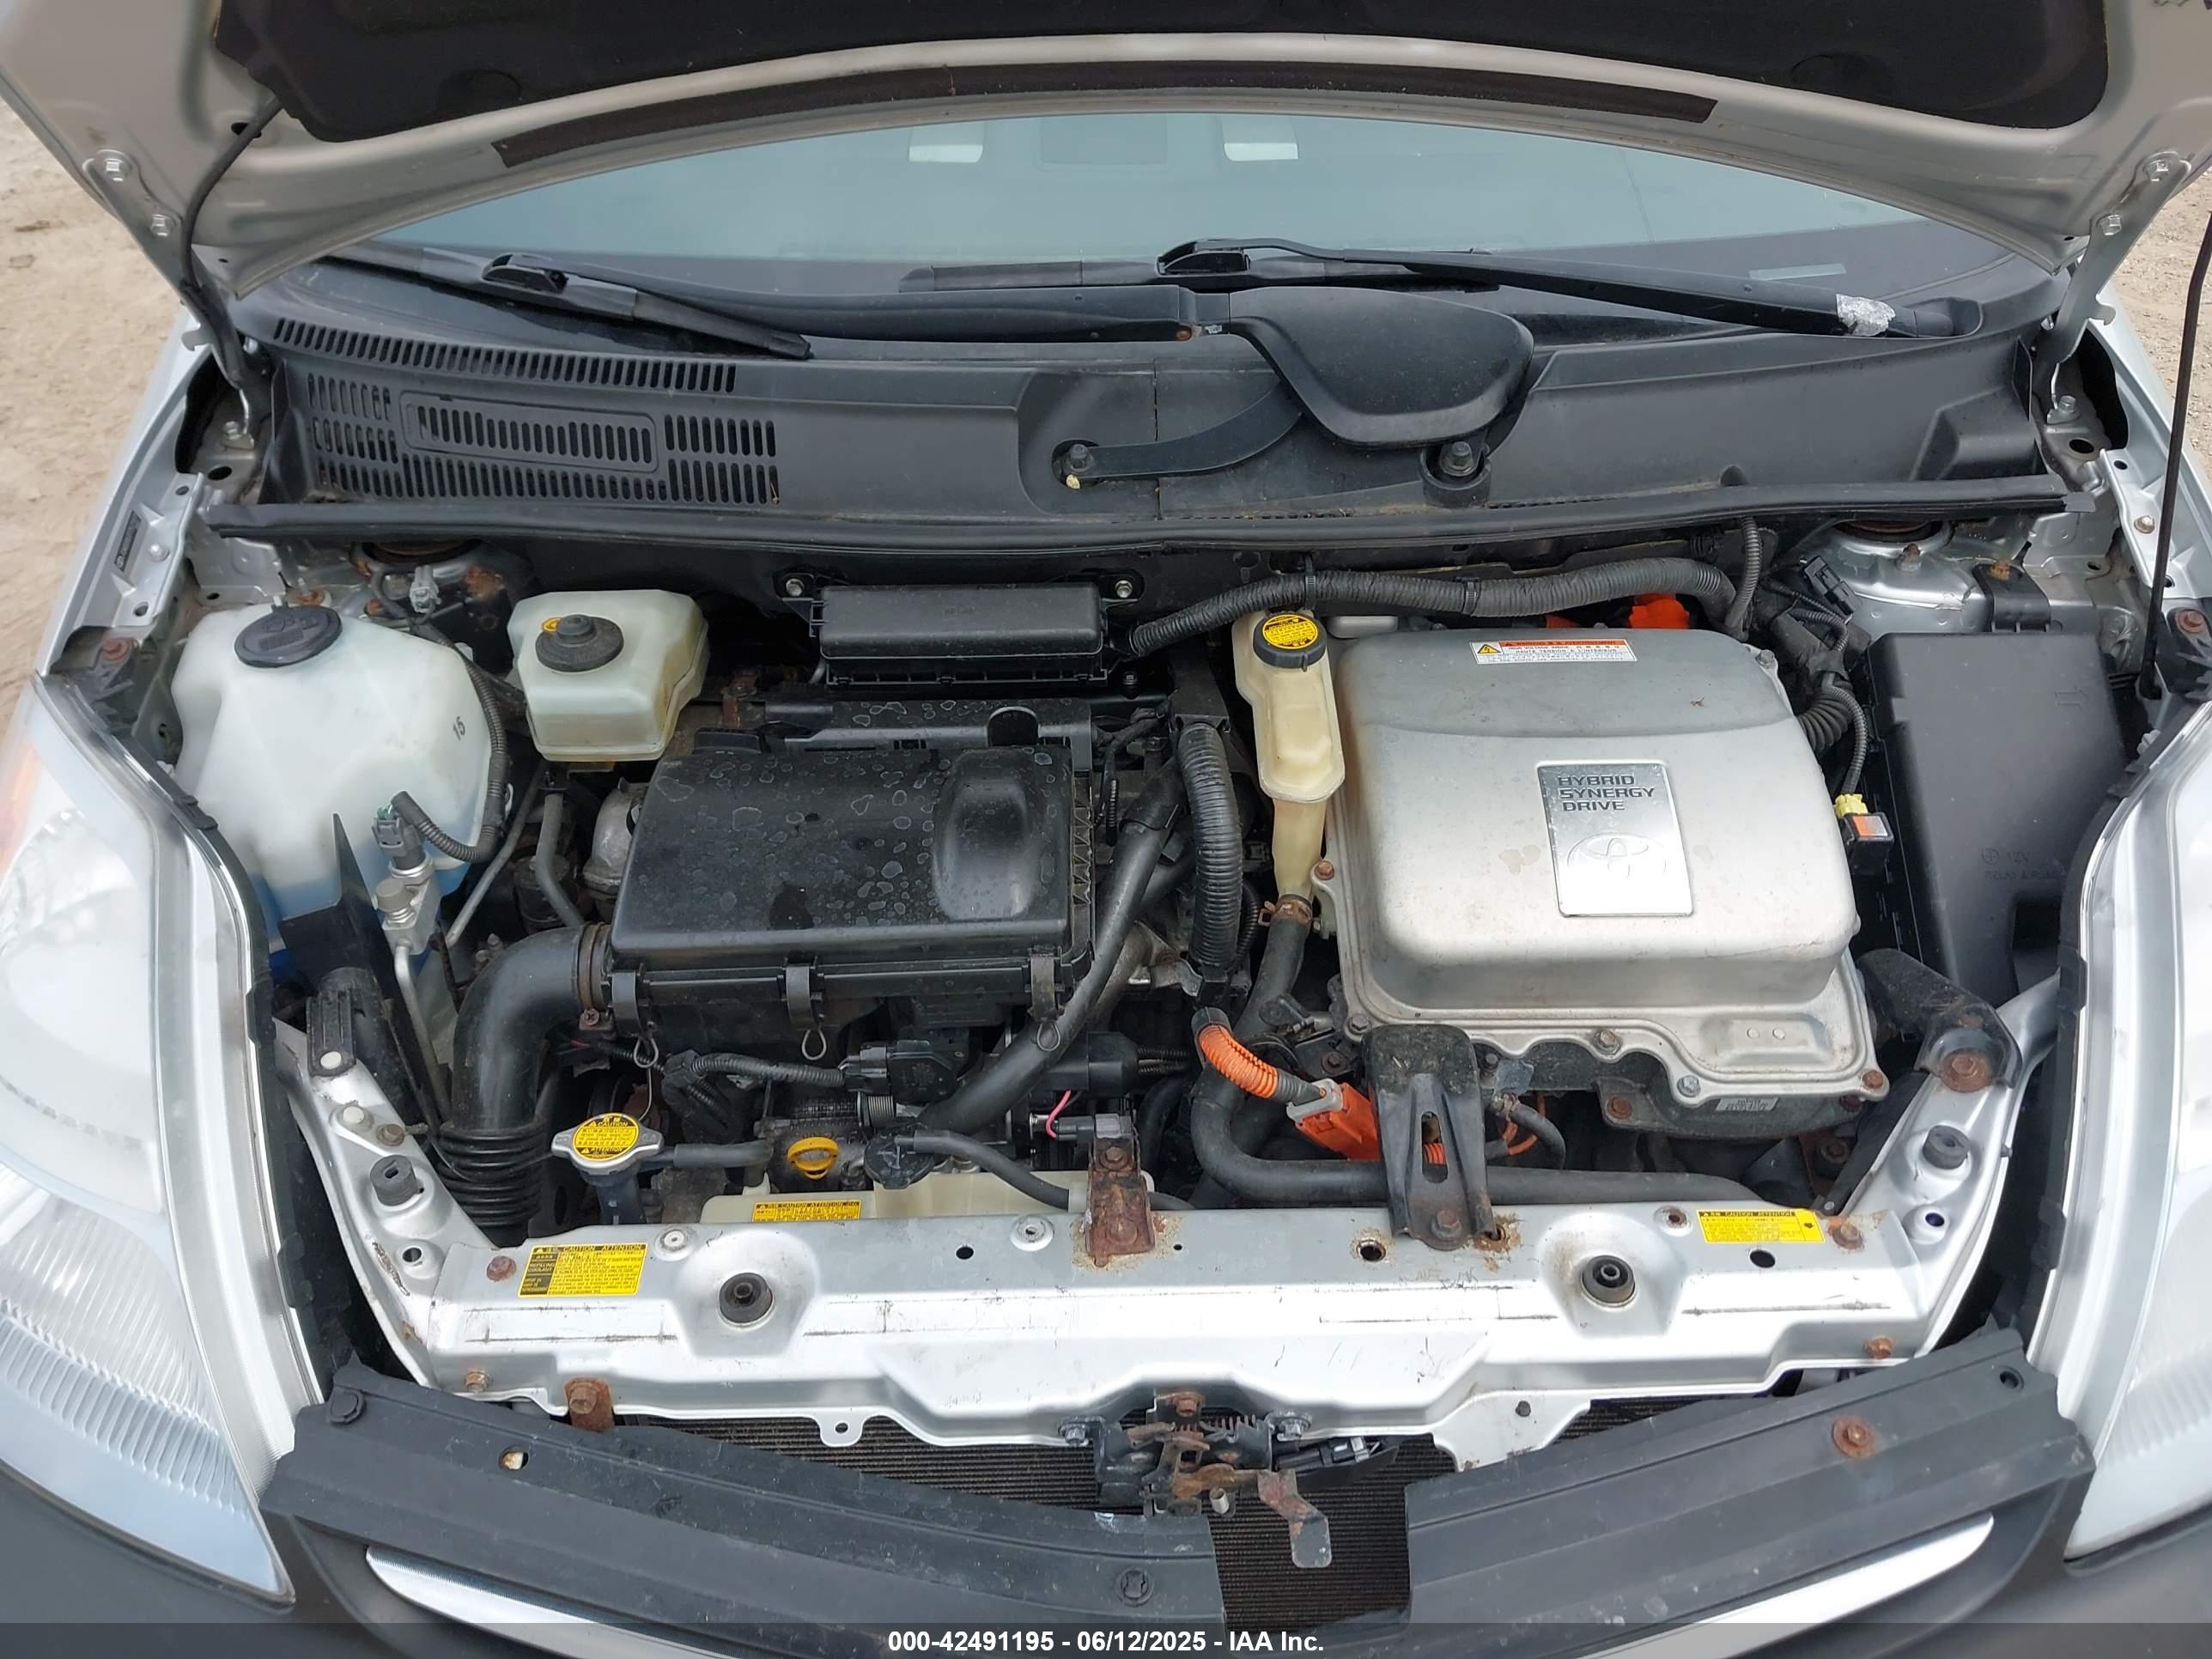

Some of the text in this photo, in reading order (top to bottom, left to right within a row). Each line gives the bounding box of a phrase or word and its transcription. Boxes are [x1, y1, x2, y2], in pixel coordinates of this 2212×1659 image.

[1558, 775, 1635, 787] HYBRID
[1559, 787, 1655, 799] SYNERGY
[1563, 800, 1626, 811] DRIVE
